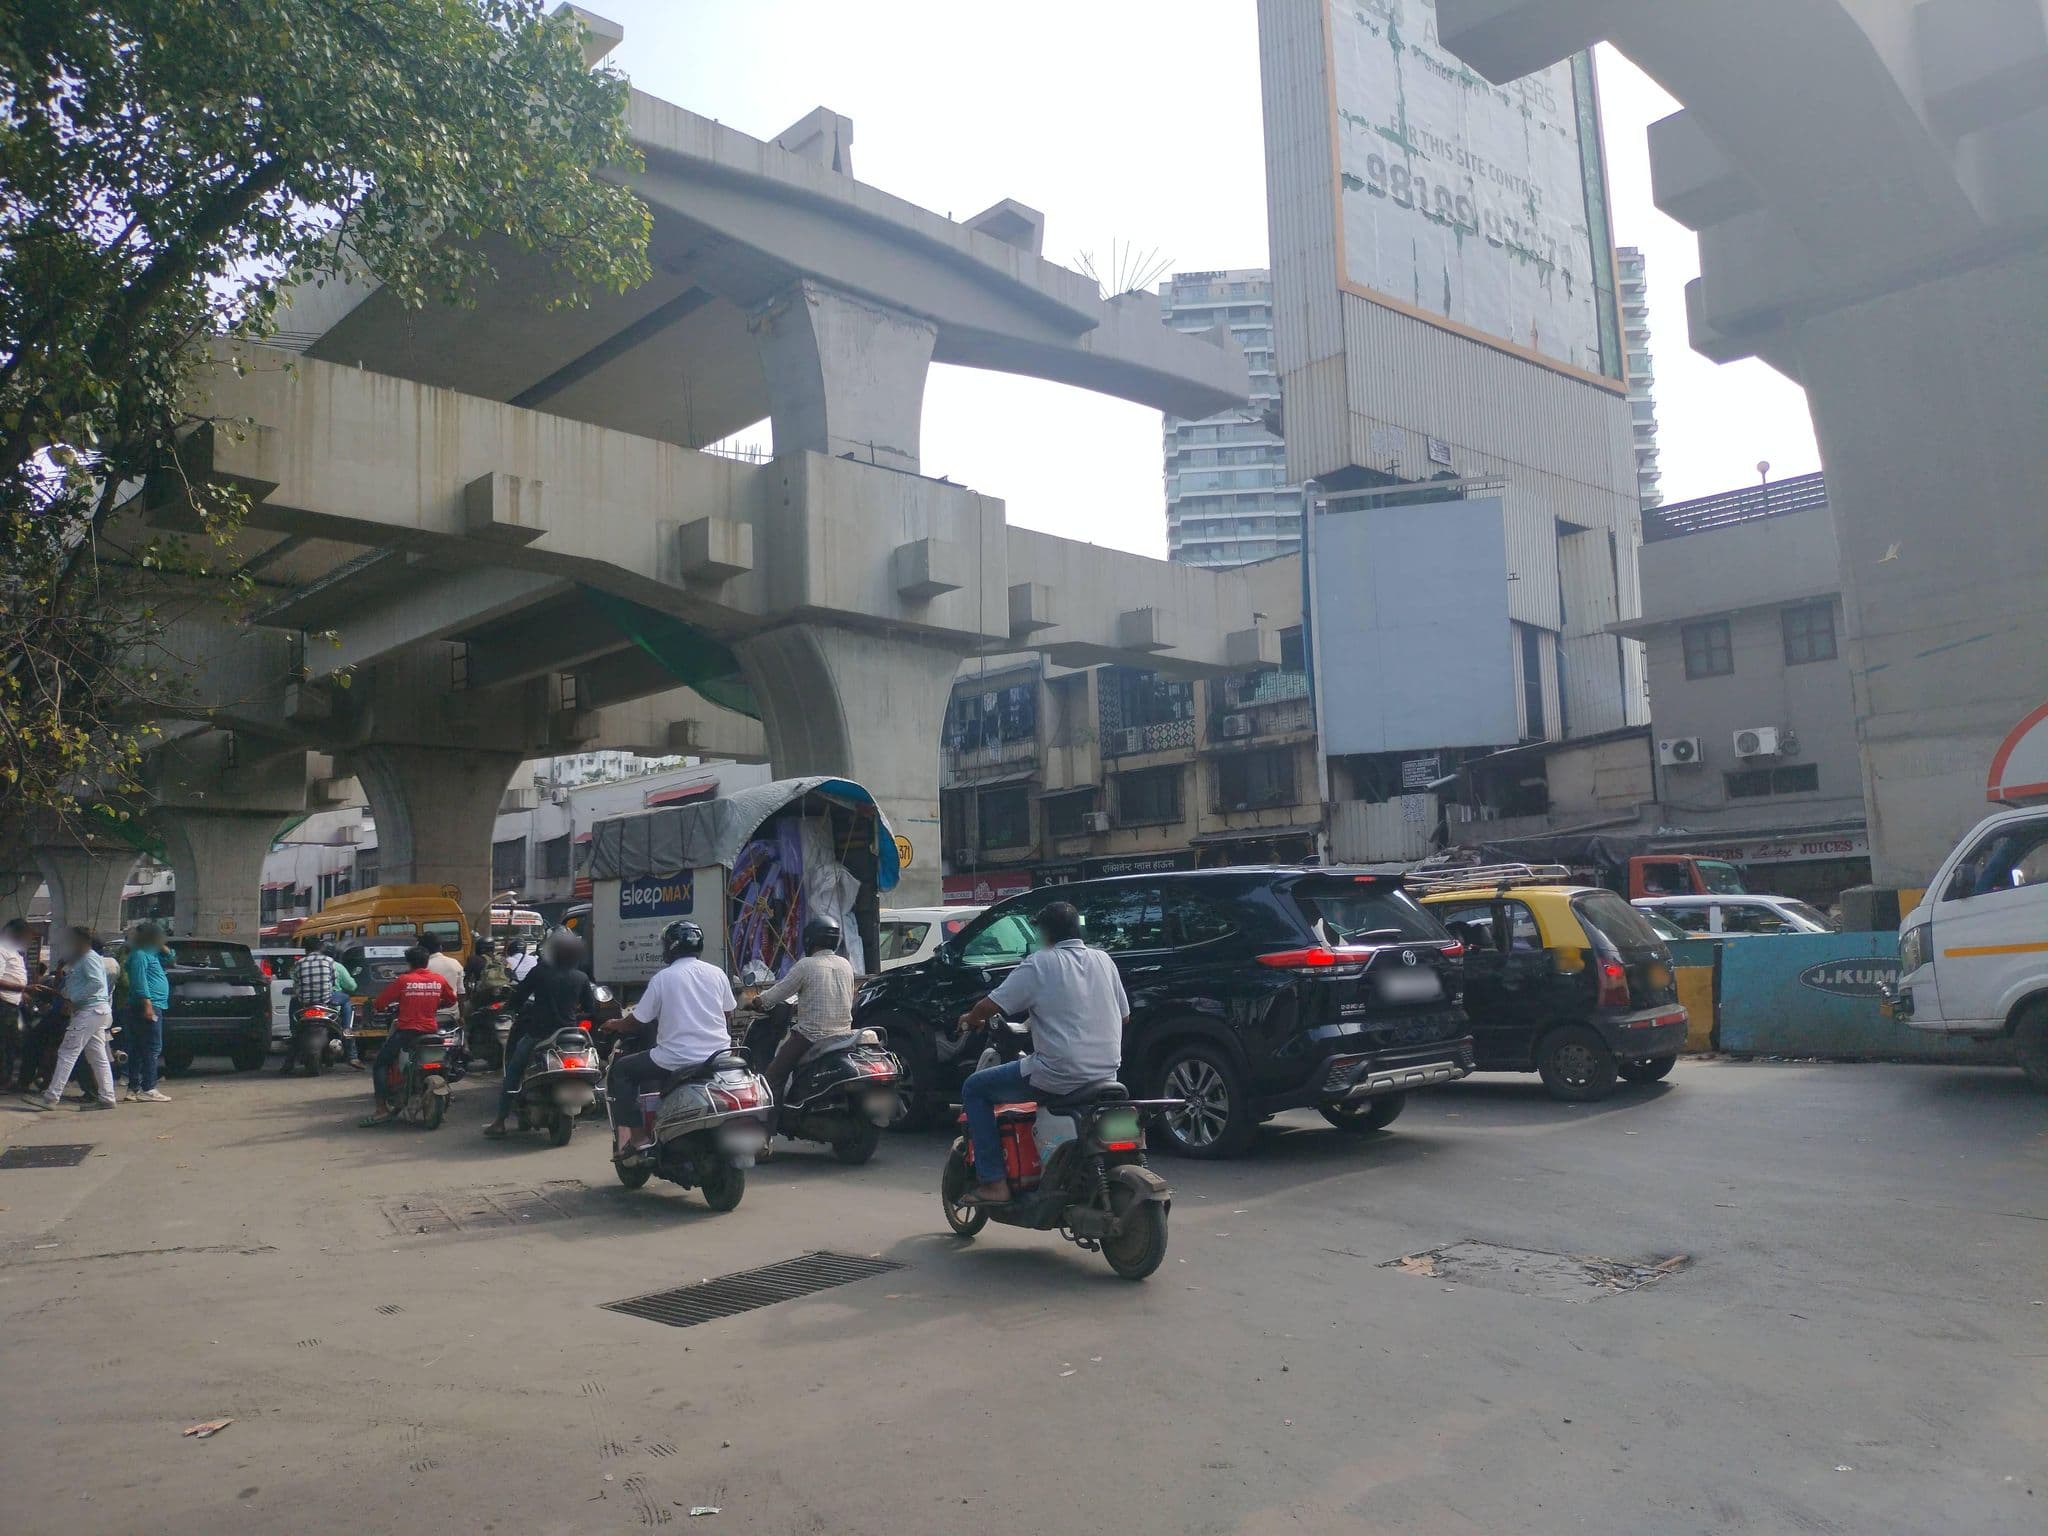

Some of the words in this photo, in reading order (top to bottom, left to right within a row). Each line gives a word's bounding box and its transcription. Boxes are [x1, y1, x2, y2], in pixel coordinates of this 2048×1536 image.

[1390, 114, 1420, 147] FR
[1422, 130, 1453, 160] THIS
[1456, 146, 1485, 177] SITE
[1489, 161, 1543, 205] CONTAT
[1800, 840, 1853, 855] JUICES
[622, 883, 690, 910] sleepMAX
[406, 981, 441, 990] zomato
